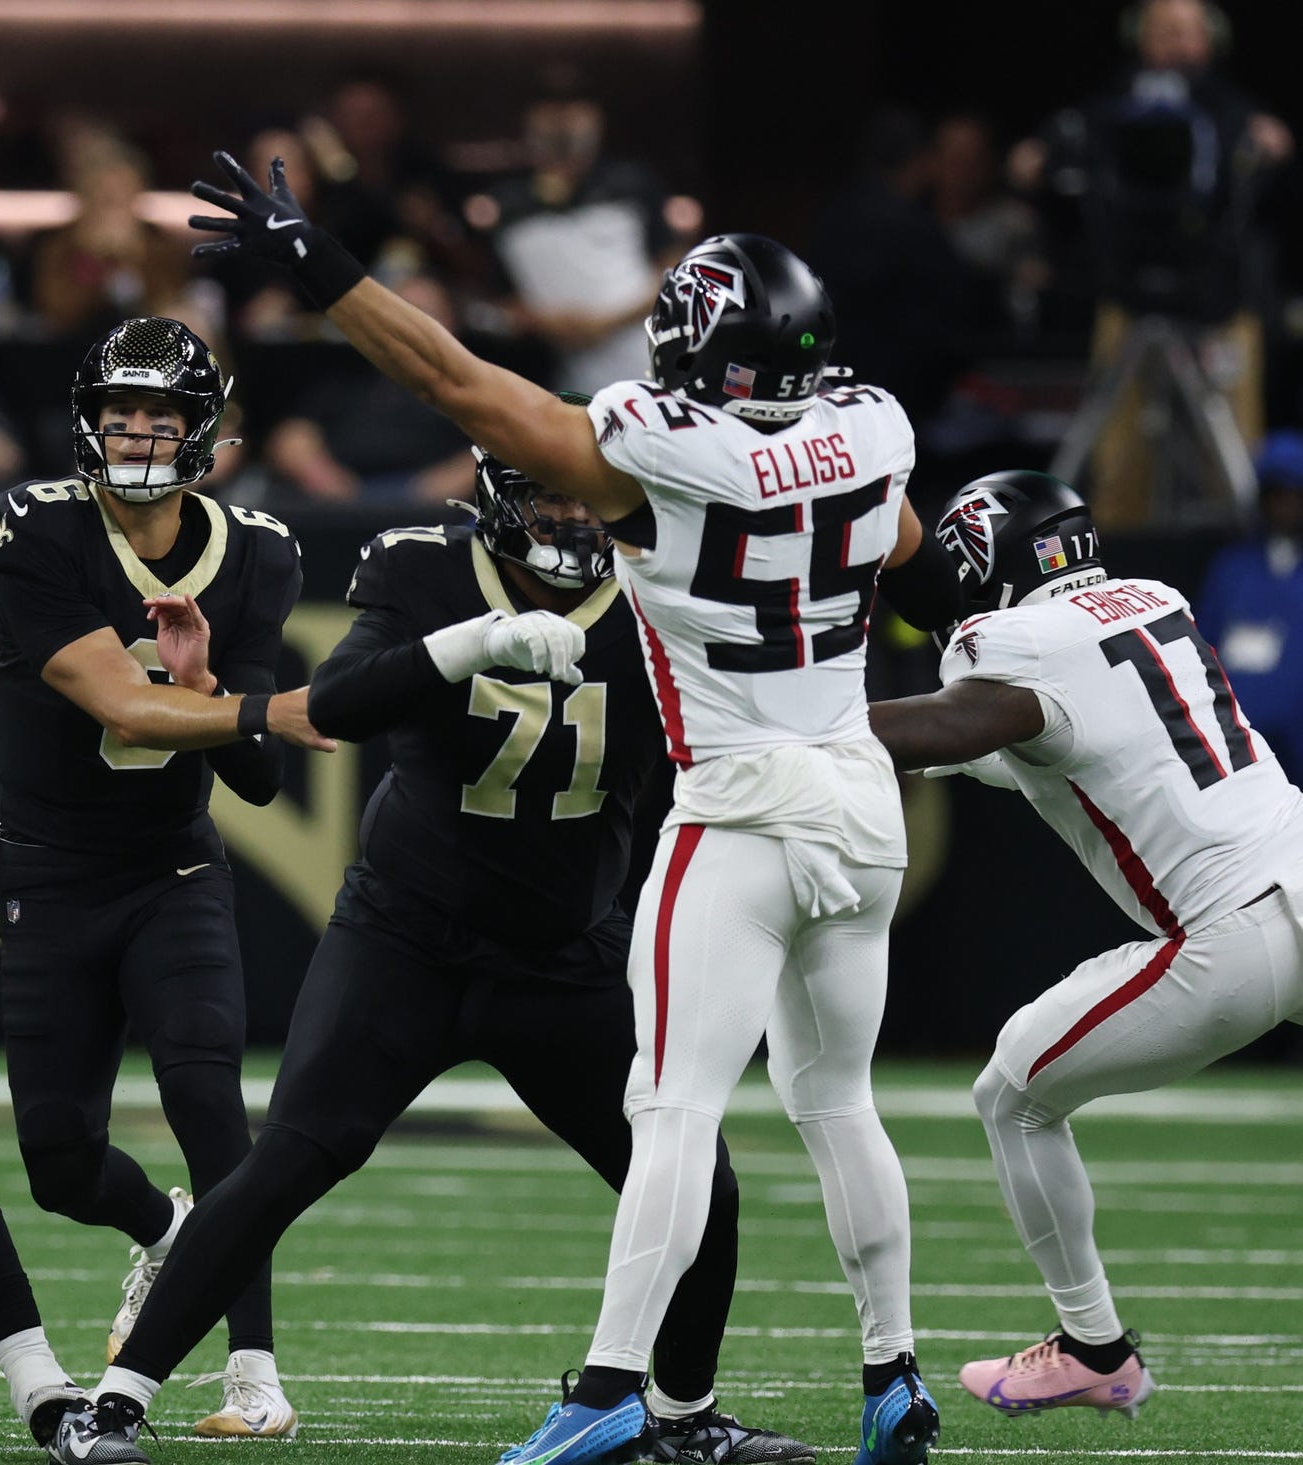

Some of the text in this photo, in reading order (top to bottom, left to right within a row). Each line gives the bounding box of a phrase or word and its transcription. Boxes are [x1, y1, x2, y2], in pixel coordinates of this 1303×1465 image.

[122, 370, 150, 379] SAINTS
[777, 373, 815, 398] 55
[750, 433, 856, 499] ELLISS
[690, 475, 891, 673] 55
[1071, 532, 1094, 560] 17
[1099, 607, 1258, 791] 17
[460, 673, 609, 821] 71
